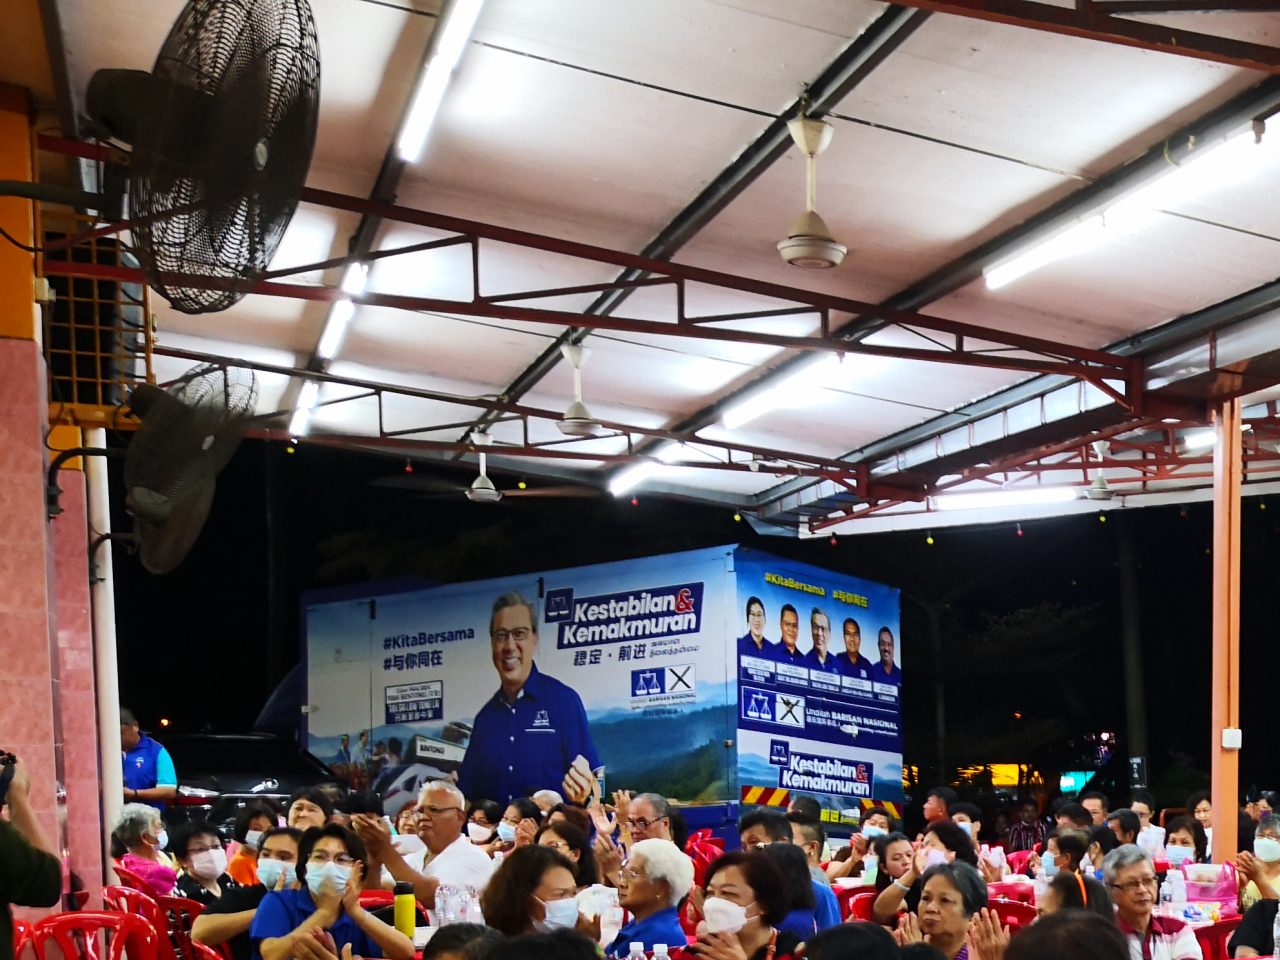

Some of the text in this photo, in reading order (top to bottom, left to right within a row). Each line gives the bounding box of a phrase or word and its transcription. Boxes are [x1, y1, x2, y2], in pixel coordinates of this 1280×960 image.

[764, 572, 826, 597] #KitaBersama
[383, 627, 475, 650] #KitaBersama
[563, 613, 697, 645] Kemakmuran
[383, 649, 444, 671] #与你同在
[831, 711, 863, 724] BARISAN
[863, 717, 899, 730] NASIONAL
[782, 770, 870, 796] Kemakmuran
